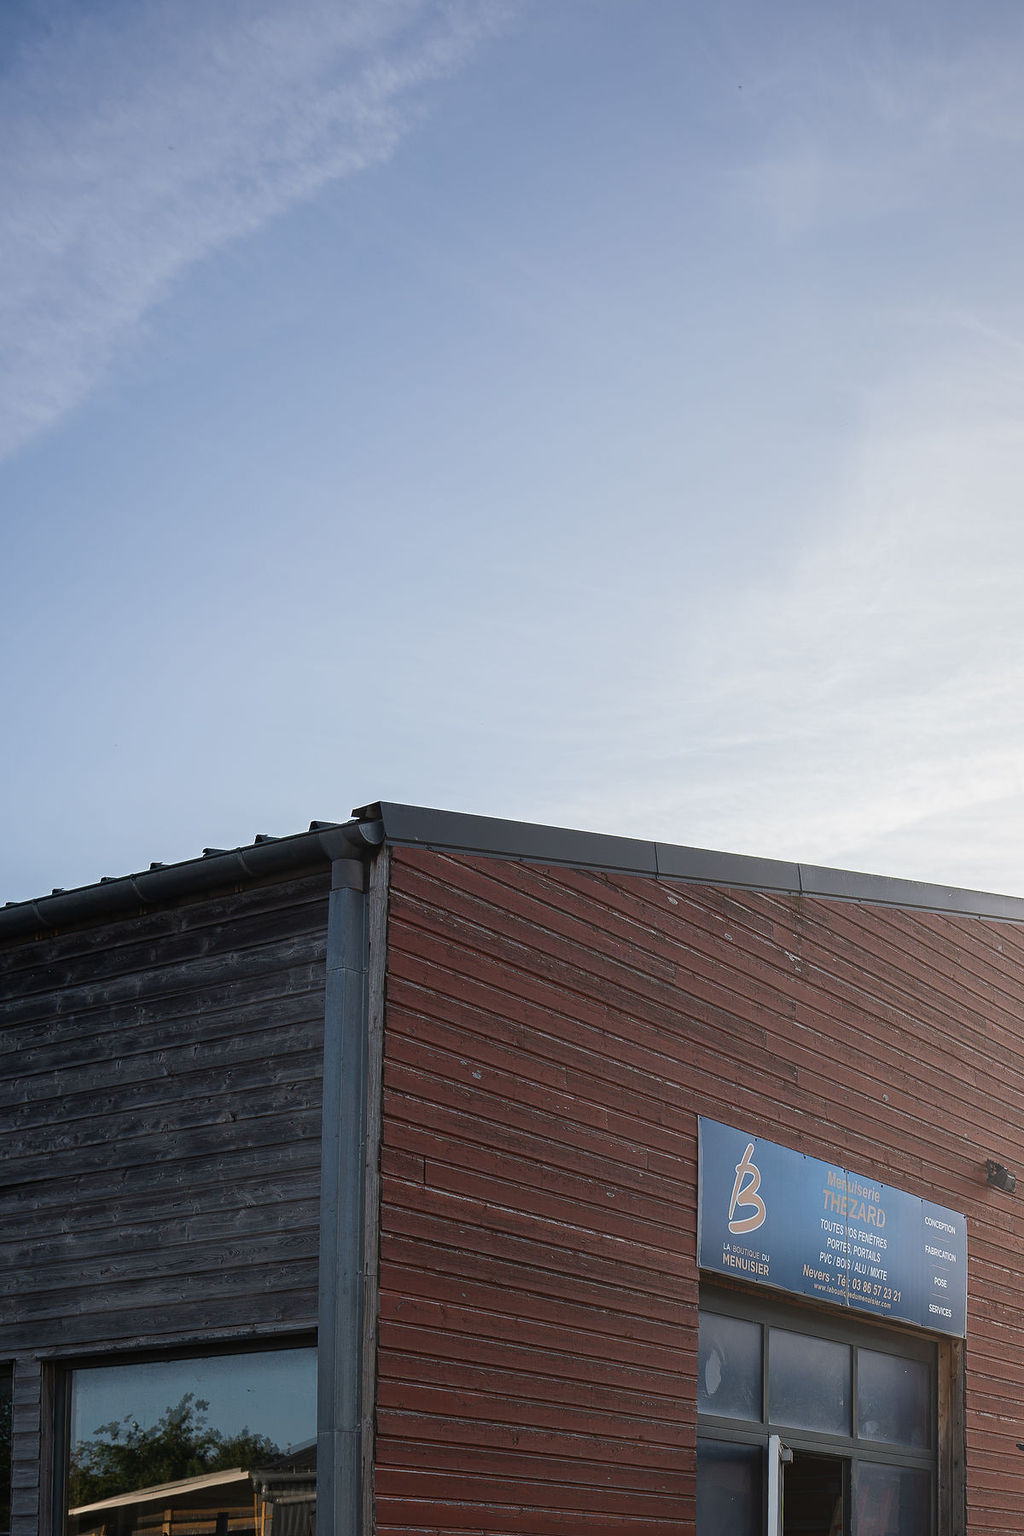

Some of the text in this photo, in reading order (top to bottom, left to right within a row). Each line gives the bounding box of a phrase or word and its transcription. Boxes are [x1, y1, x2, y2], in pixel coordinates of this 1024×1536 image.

[827, 1170, 880, 1203] Menuiserie
[823, 1189, 886, 1228] THEZARD
[820, 1218, 844, 1235] TOUTES
[925, 1216, 956, 1235] CONCEPTION
[723, 1242, 770, 1262] LA BOUTIQUE DU
[853, 1245, 881, 1263] PORTAILS
[925, 1245, 957, 1263] FABRICATION
[722, 1253, 769, 1276] MENUISIER
[820, 1252, 832, 1265] PVC
[836, 1256, 850, 1270] BOIS
[854, 1262, 867, 1275] ALU
[870, 1266, 887, 1281] MIXTE
[802, 1263, 830, 1283] Nevers
[837, 1273, 850, 1288] Té:
[852, 1278, 861, 1291] 03
[862, 1281, 872, 1294] 86
[873, 1284, 882, 1298] 57
[883, 1287, 892, 1301] 23
[893, 1290, 902, 1303] 21
[934, 1276, 948, 1289] POSE
[928, 1303, 952, 1318] SERVICES
